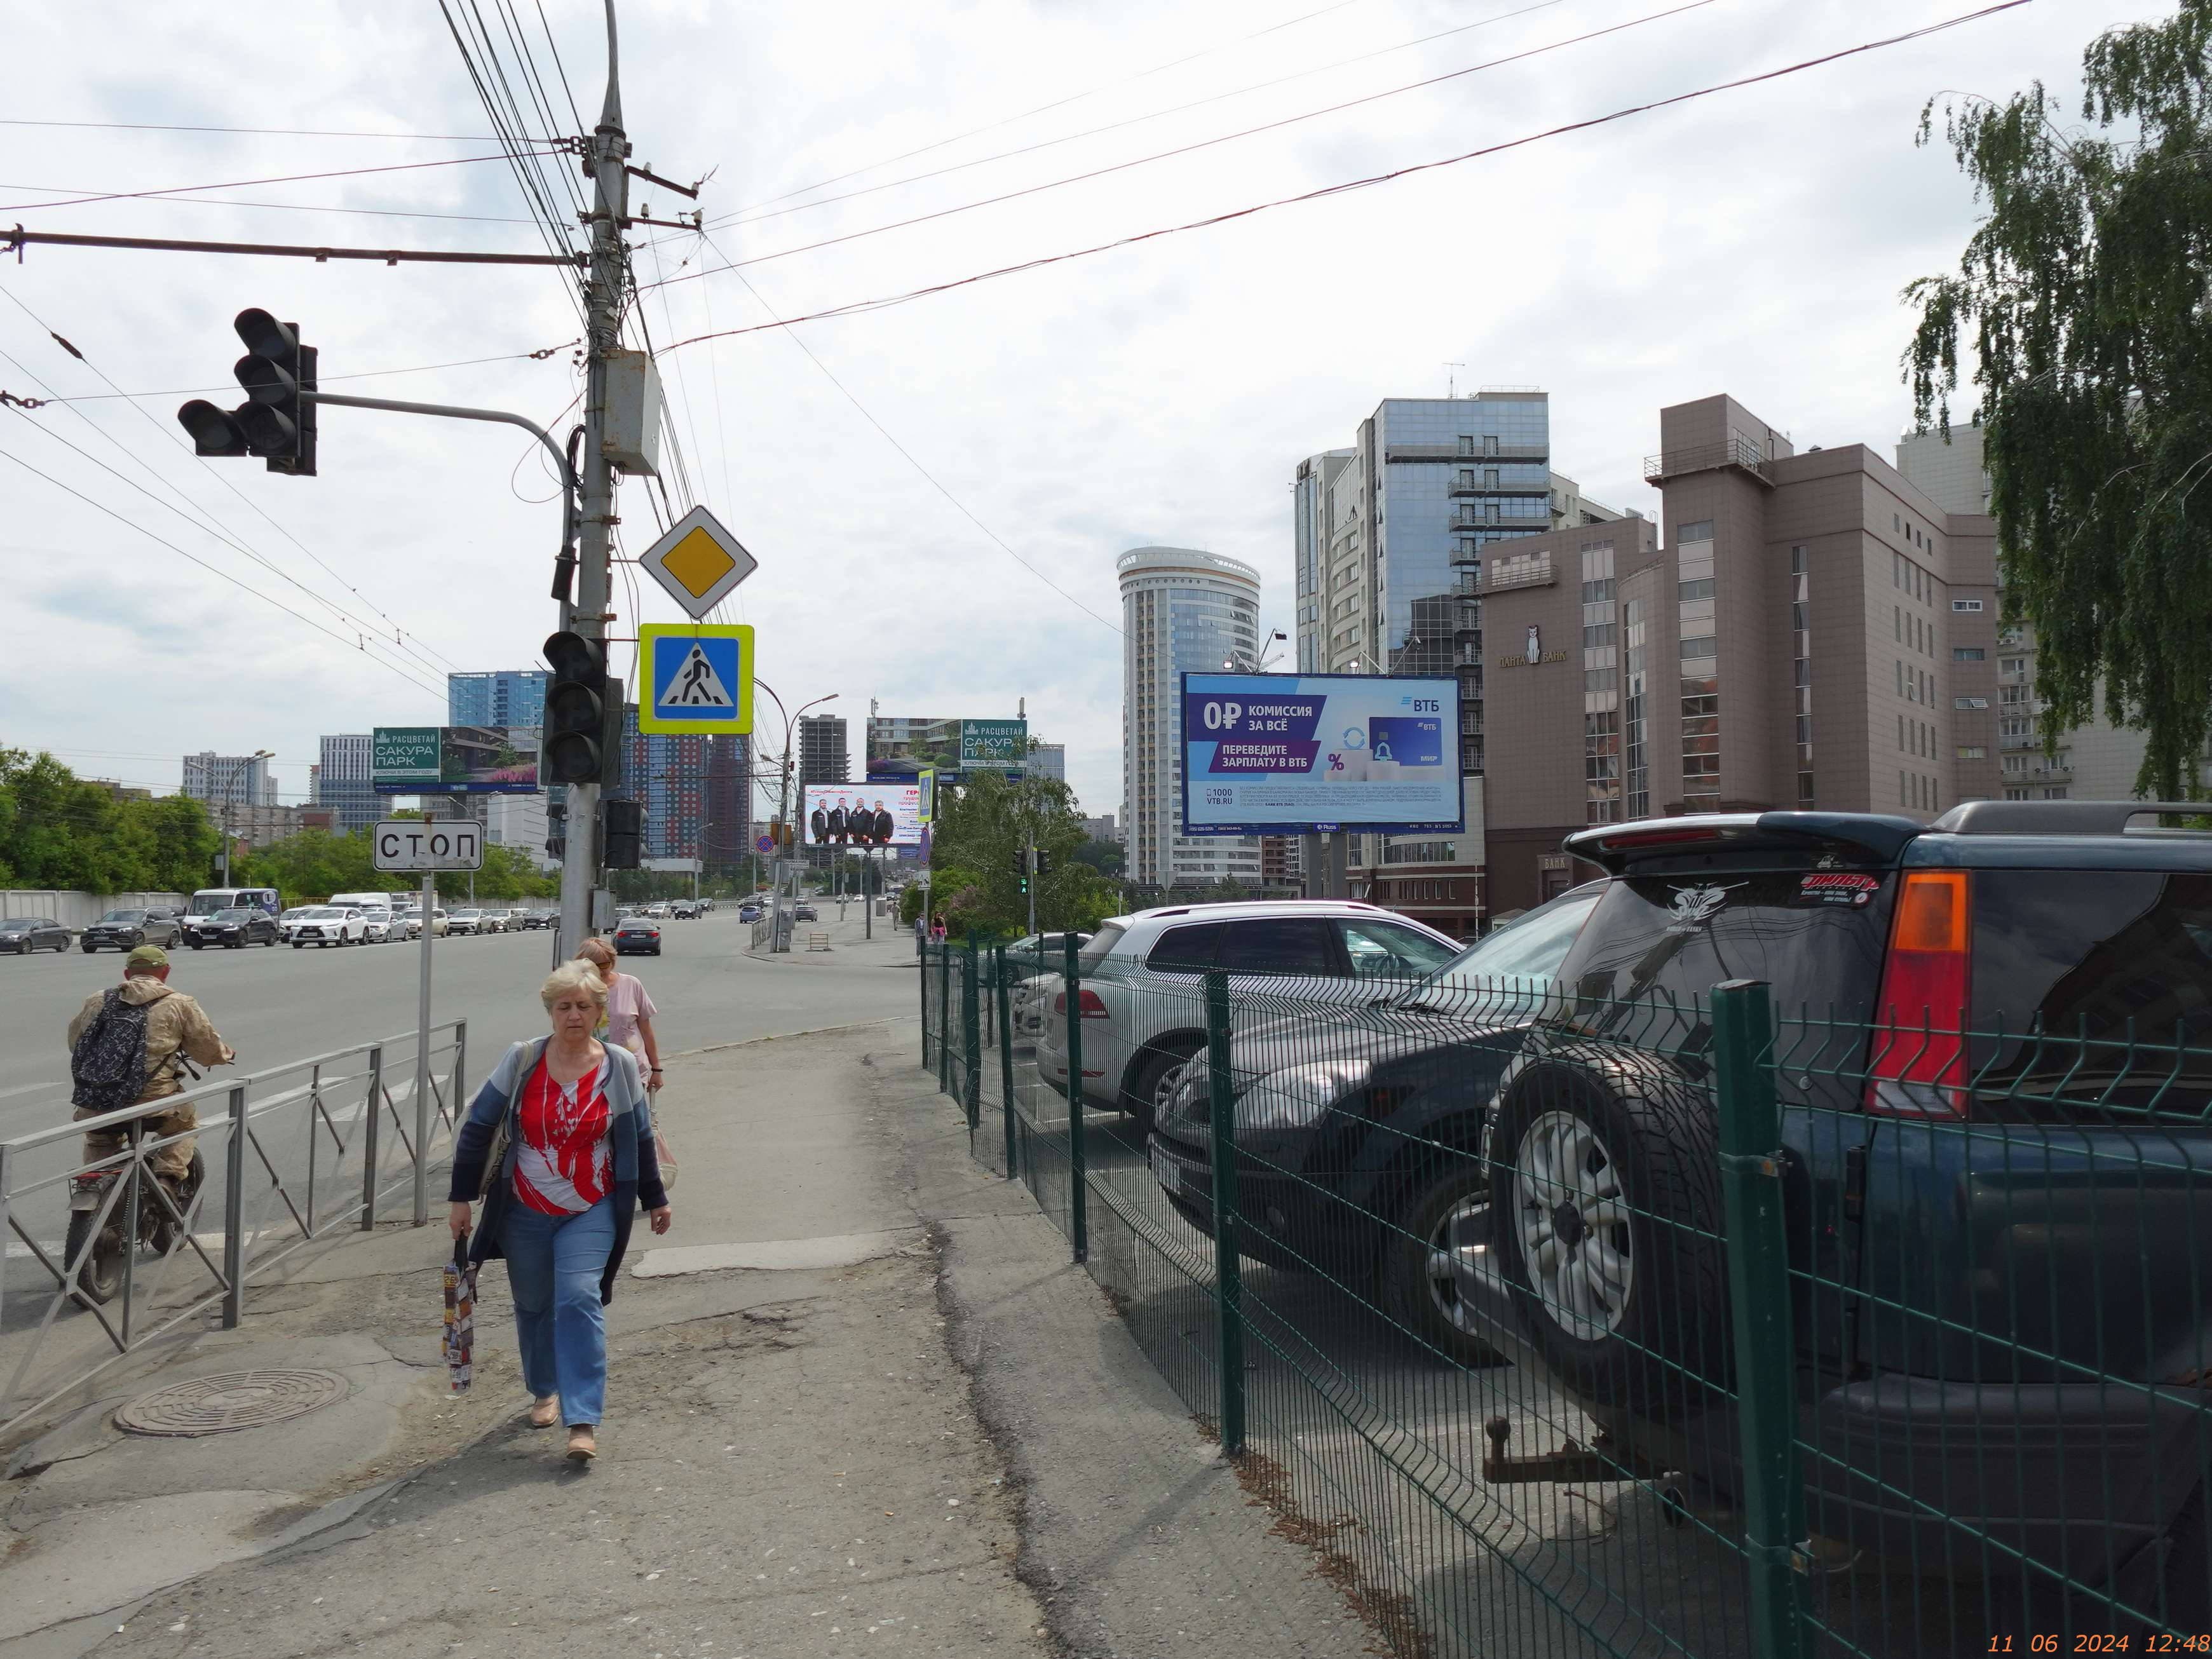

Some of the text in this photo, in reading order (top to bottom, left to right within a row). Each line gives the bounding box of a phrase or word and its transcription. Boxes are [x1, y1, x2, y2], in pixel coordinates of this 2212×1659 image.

[1500, 650, 1566, 667] ЛАНТА БАНК
[1249, 705, 1312, 717] КОМИССИЯ
[1414, 700, 1439, 712] ВТБ
[1249, 718, 1287, 731] ЗА ВСЁ
[981, 727, 1022, 736] РАСЦВЕТАЙ
[392, 734, 435, 744] РАСЦВЕТАЙ
[965, 738, 1017, 747] САКУР
[376, 747, 433, 755] САКУРА
[1223, 745, 1287, 755] ПЕРЕВЕДИТЕ
[376, 757, 415, 766] ПАРК
[1223, 757, 1307, 768] ЗАРПЛАТУ В ВТБ
[381, 834, 474, 858] СТОП
[1545, 858, 1565, 869] БАНК
